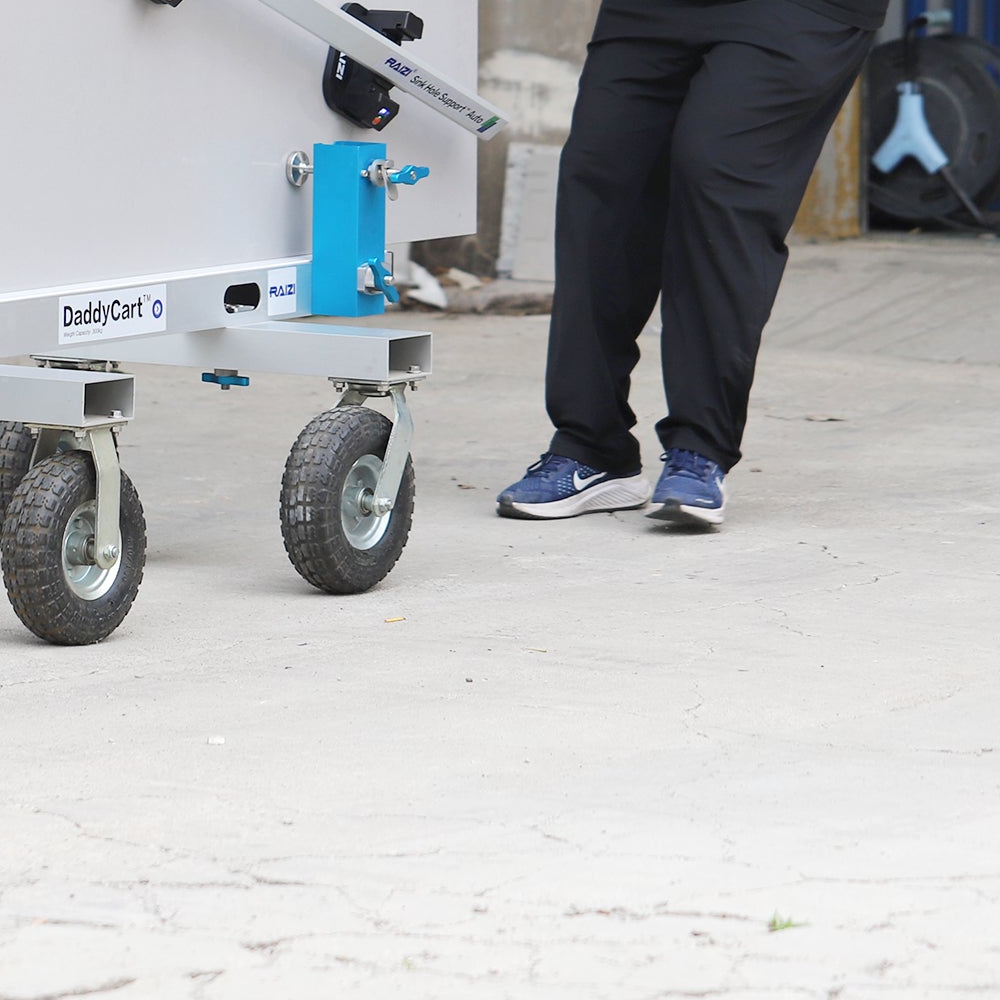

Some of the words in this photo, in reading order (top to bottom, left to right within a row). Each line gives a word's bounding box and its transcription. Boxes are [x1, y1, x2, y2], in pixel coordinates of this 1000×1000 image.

[384, 57, 412, 77] RAIZI
[410, 75, 427, 89] Sink
[423, 83, 441, 98] Hole
[465, 110, 484, 124] Auto
[269, 283, 296, 298] RAIZI
